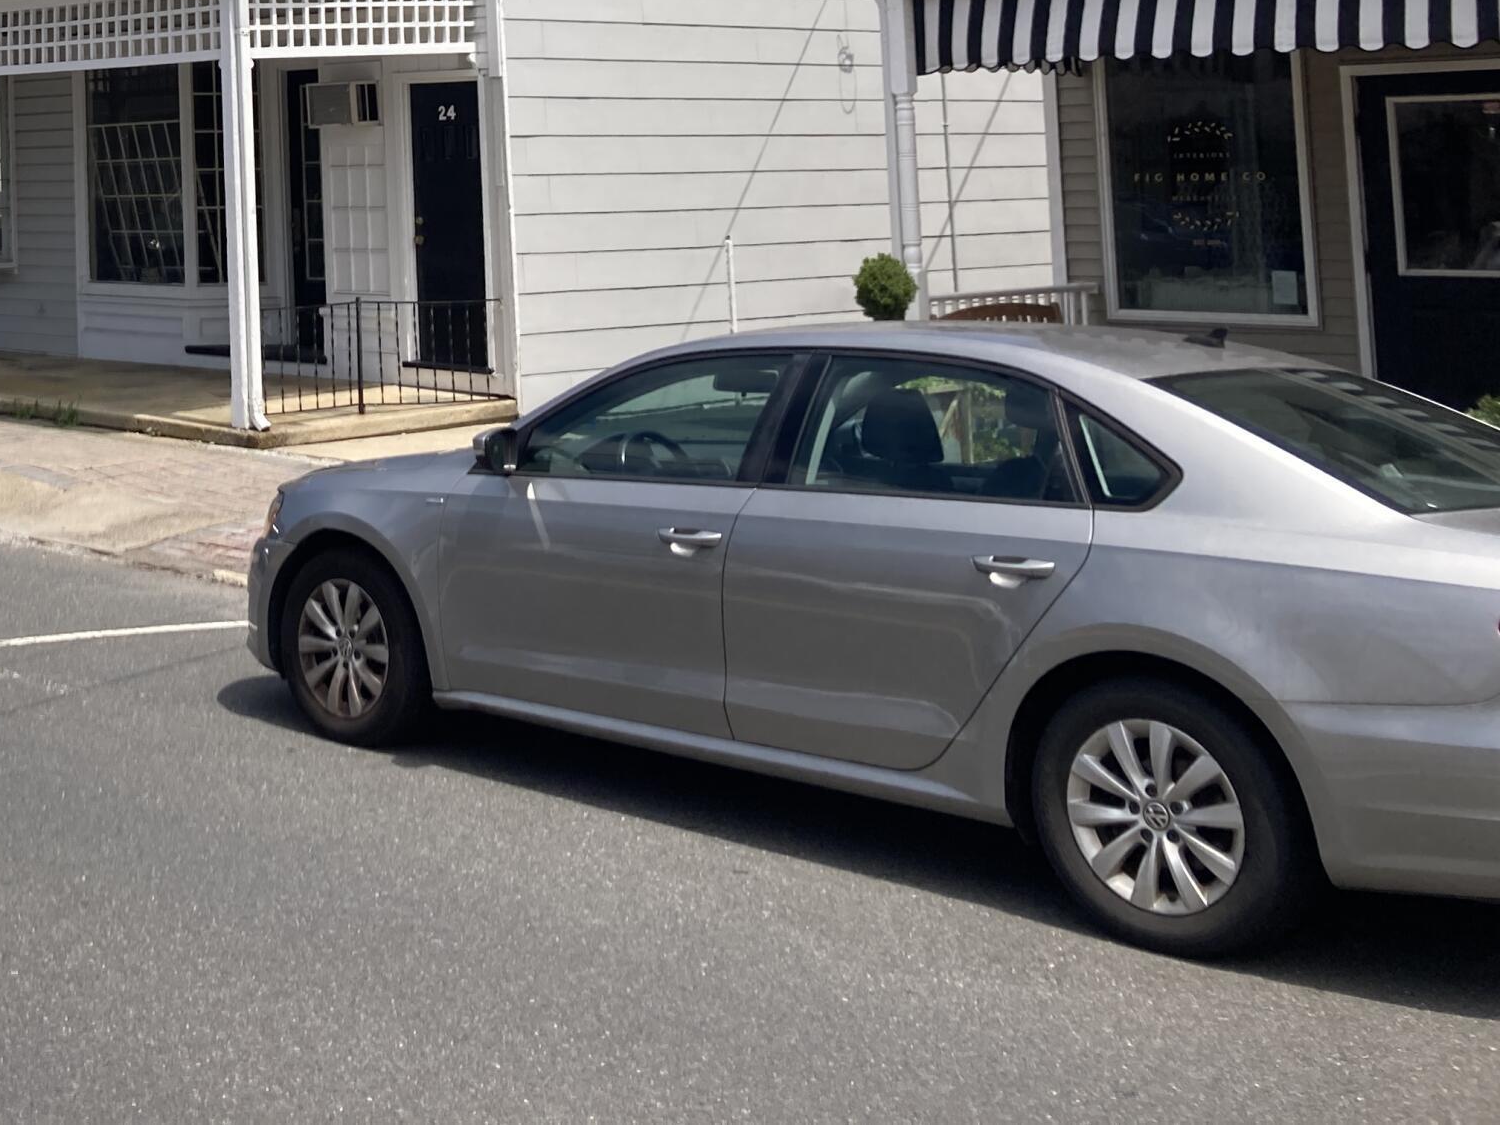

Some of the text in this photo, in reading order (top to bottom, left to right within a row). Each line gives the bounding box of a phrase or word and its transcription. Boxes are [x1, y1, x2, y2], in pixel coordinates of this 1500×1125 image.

[438, 105, 456, 121] 24
[1133, 173, 1164, 183] FIG
[1176, 172, 1229, 182] HOME
